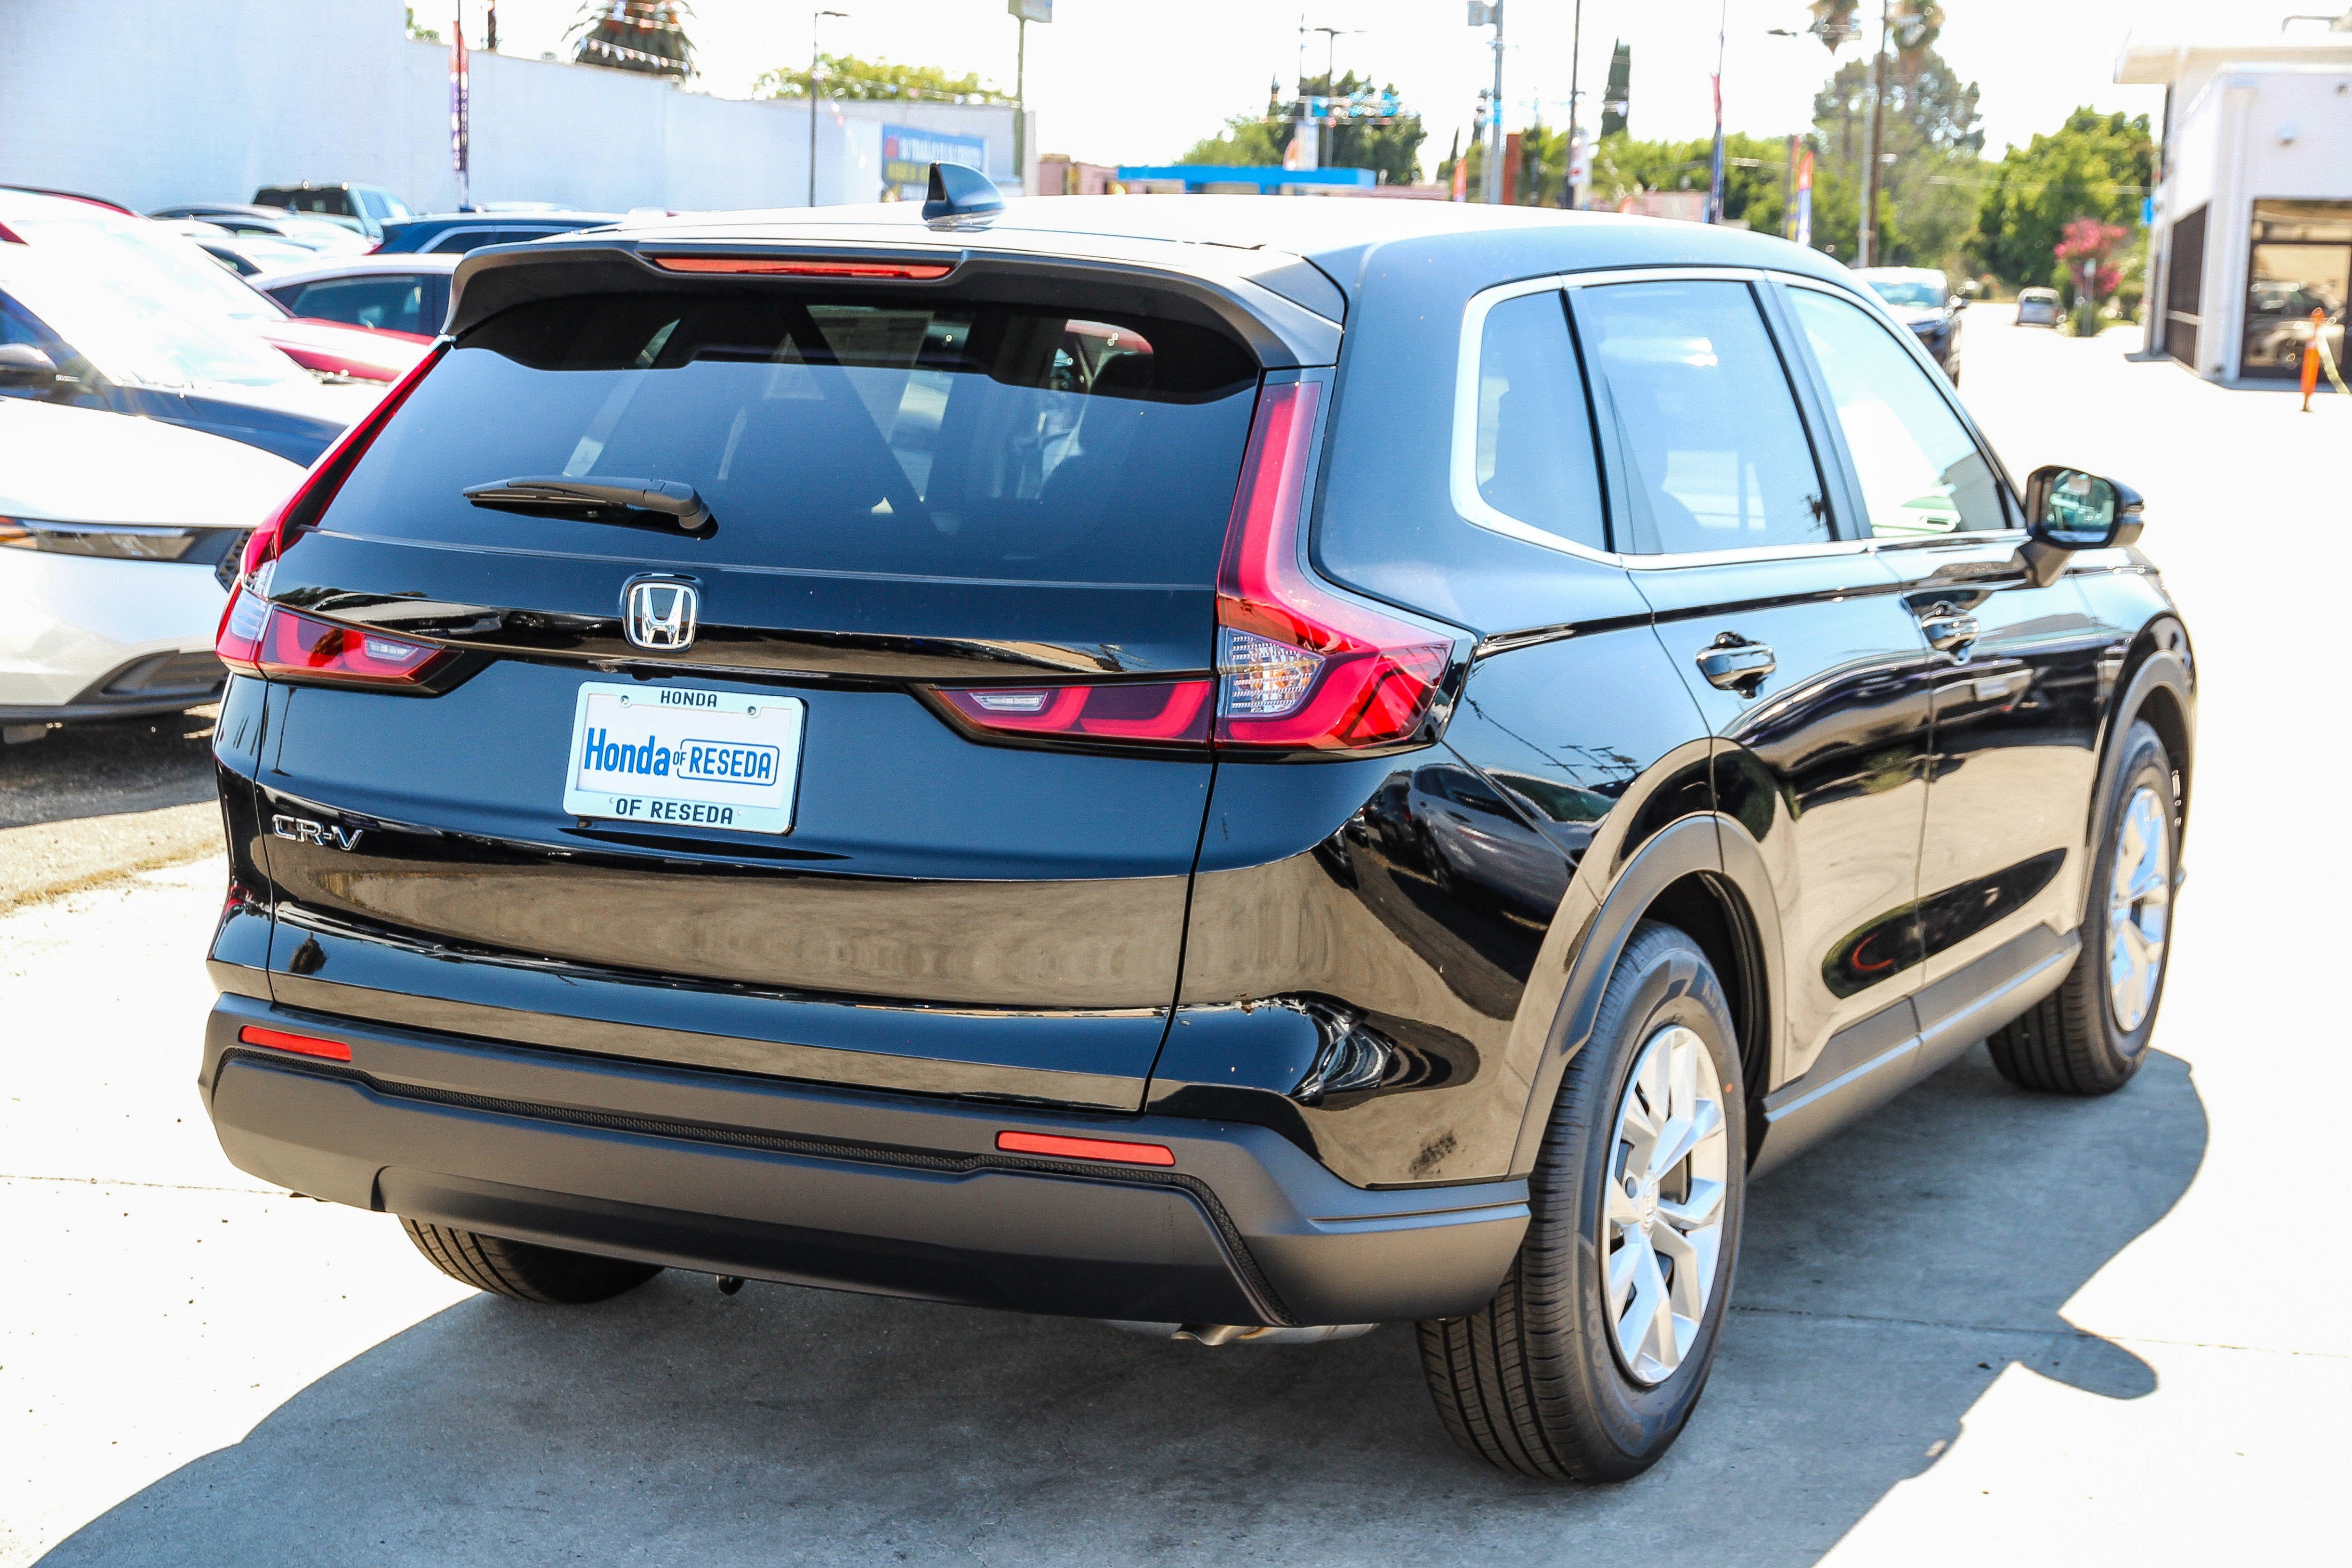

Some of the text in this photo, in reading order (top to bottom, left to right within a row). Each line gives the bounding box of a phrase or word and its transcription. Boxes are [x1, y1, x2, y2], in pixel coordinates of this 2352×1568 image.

[660, 690, 717, 707] HONDA
[584, 727, 771, 779] Honda OF RESEDA
[616, 798, 733, 824] OF RESEDA
[272, 814, 364, 851] CR-V
